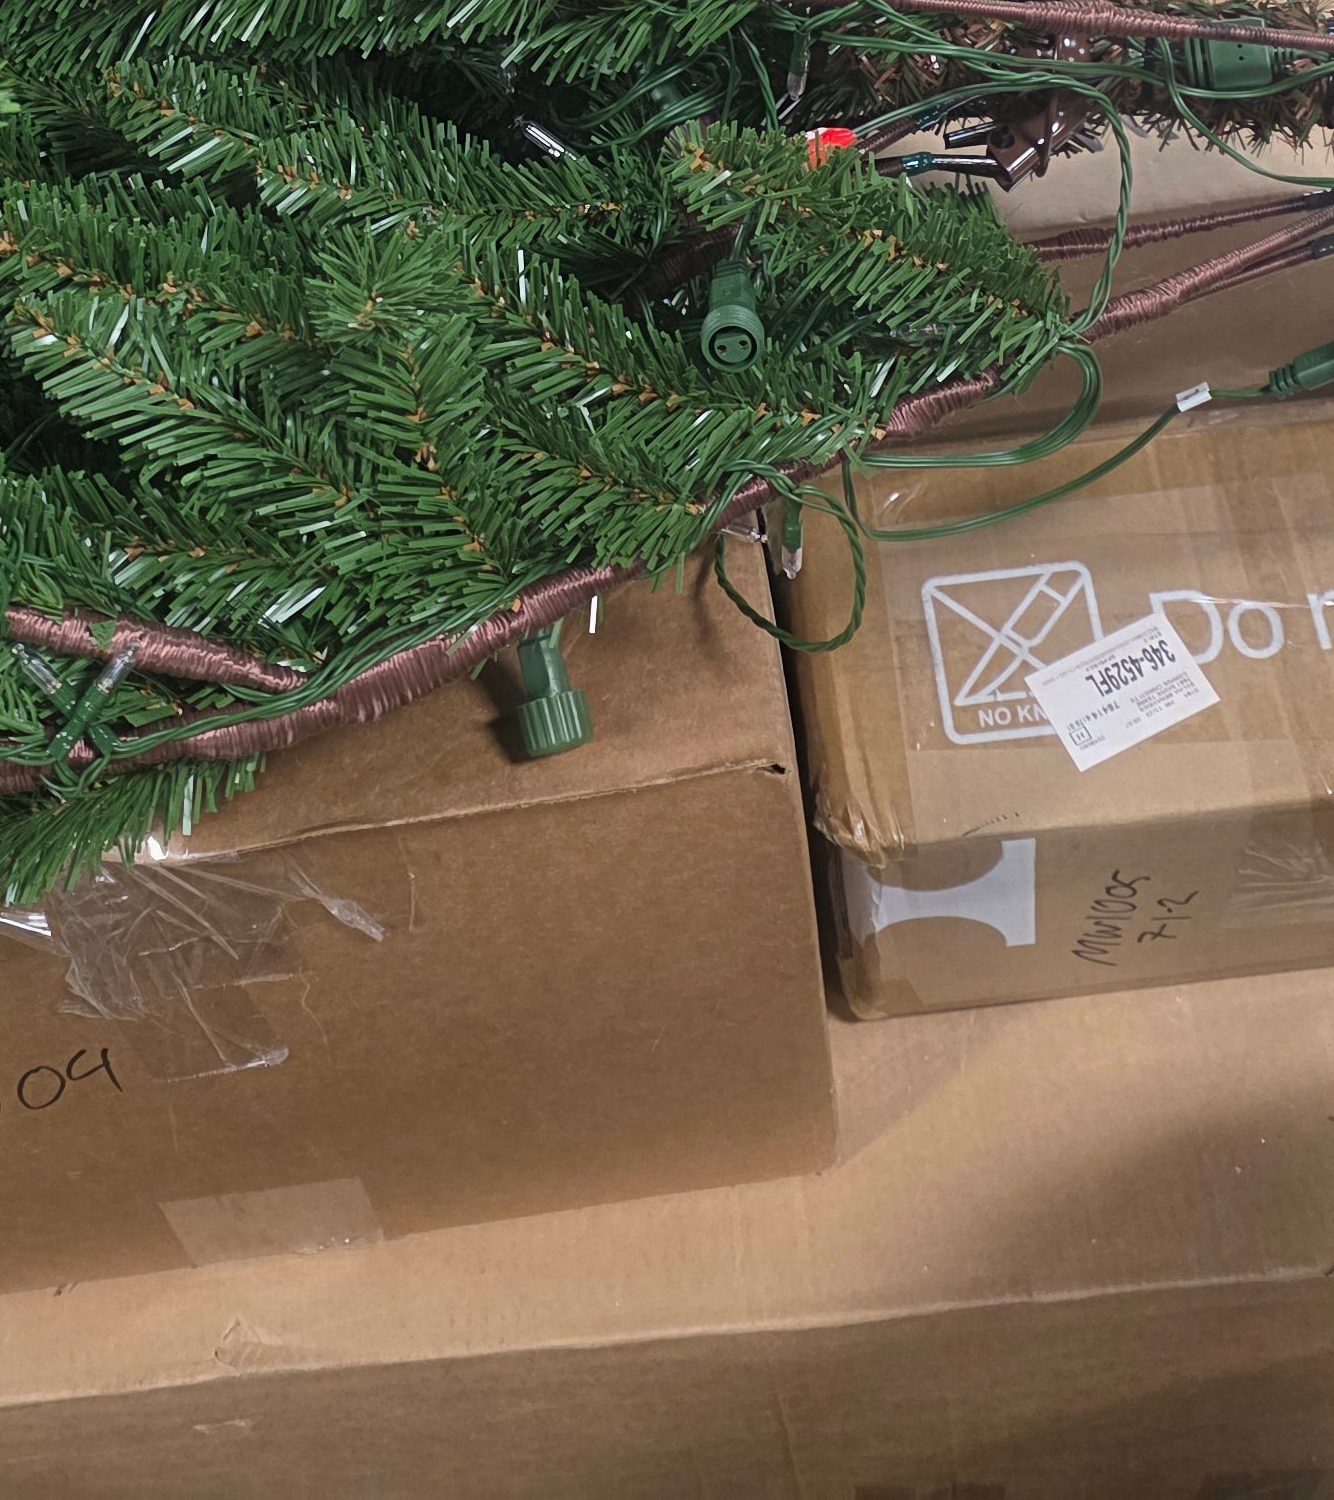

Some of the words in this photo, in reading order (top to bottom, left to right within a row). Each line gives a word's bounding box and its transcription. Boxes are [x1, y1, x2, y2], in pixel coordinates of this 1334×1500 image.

[1149, 590, 1285, 665] Do
[1083, 637, 1178, 700] 346-4529FL
[978, 706, 1012, 728] NO
[1017, 703, 1049, 724] KN
